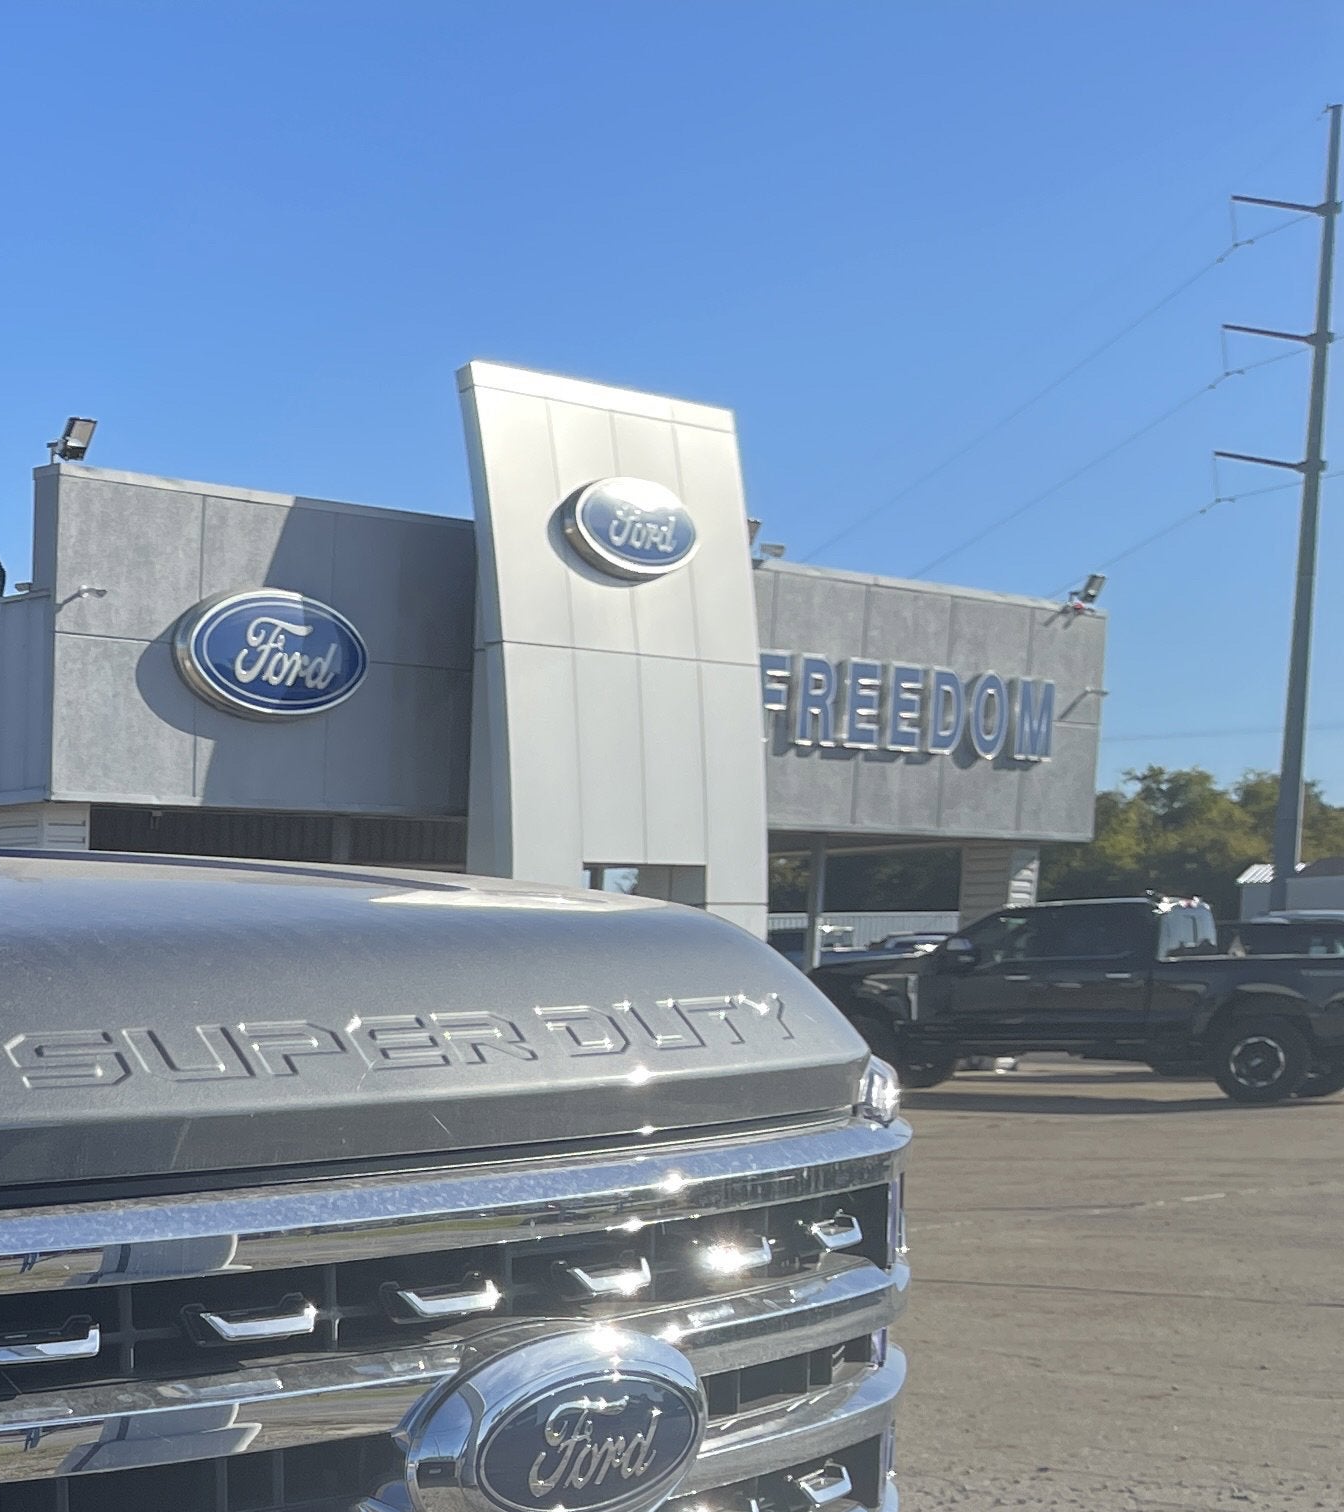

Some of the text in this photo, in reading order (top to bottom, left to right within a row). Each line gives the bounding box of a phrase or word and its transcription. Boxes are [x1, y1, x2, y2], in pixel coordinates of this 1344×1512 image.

[608, 500, 677, 553] Ford
[234, 616, 342, 690] Ford
[760, 648, 1057, 763] FREEDOM
[4, 991, 796, 1089] SUPER DUTY
[528, 1396, 663, 1498] Ford
